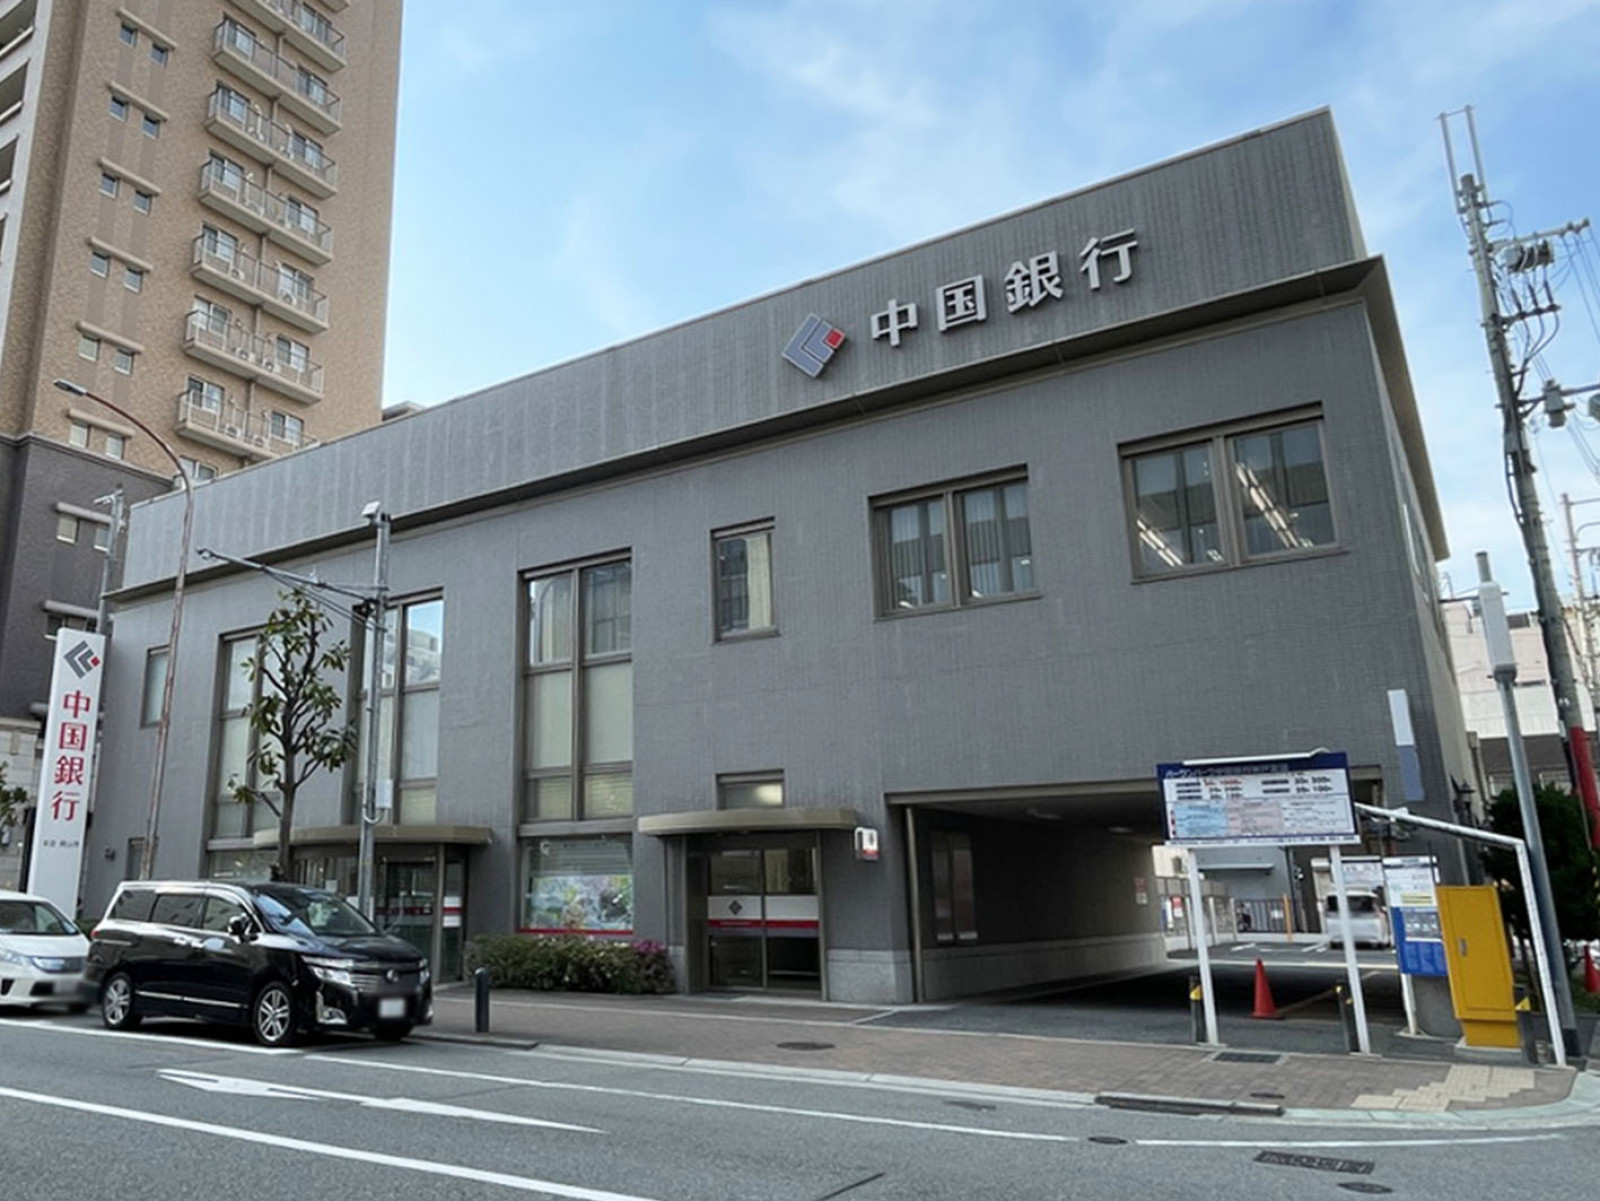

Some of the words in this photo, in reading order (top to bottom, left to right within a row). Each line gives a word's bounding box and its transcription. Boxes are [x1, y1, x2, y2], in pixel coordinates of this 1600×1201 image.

[870, 228, 1138, 347] 中国銀行
[51, 690, 91, 821] 中国銀行
